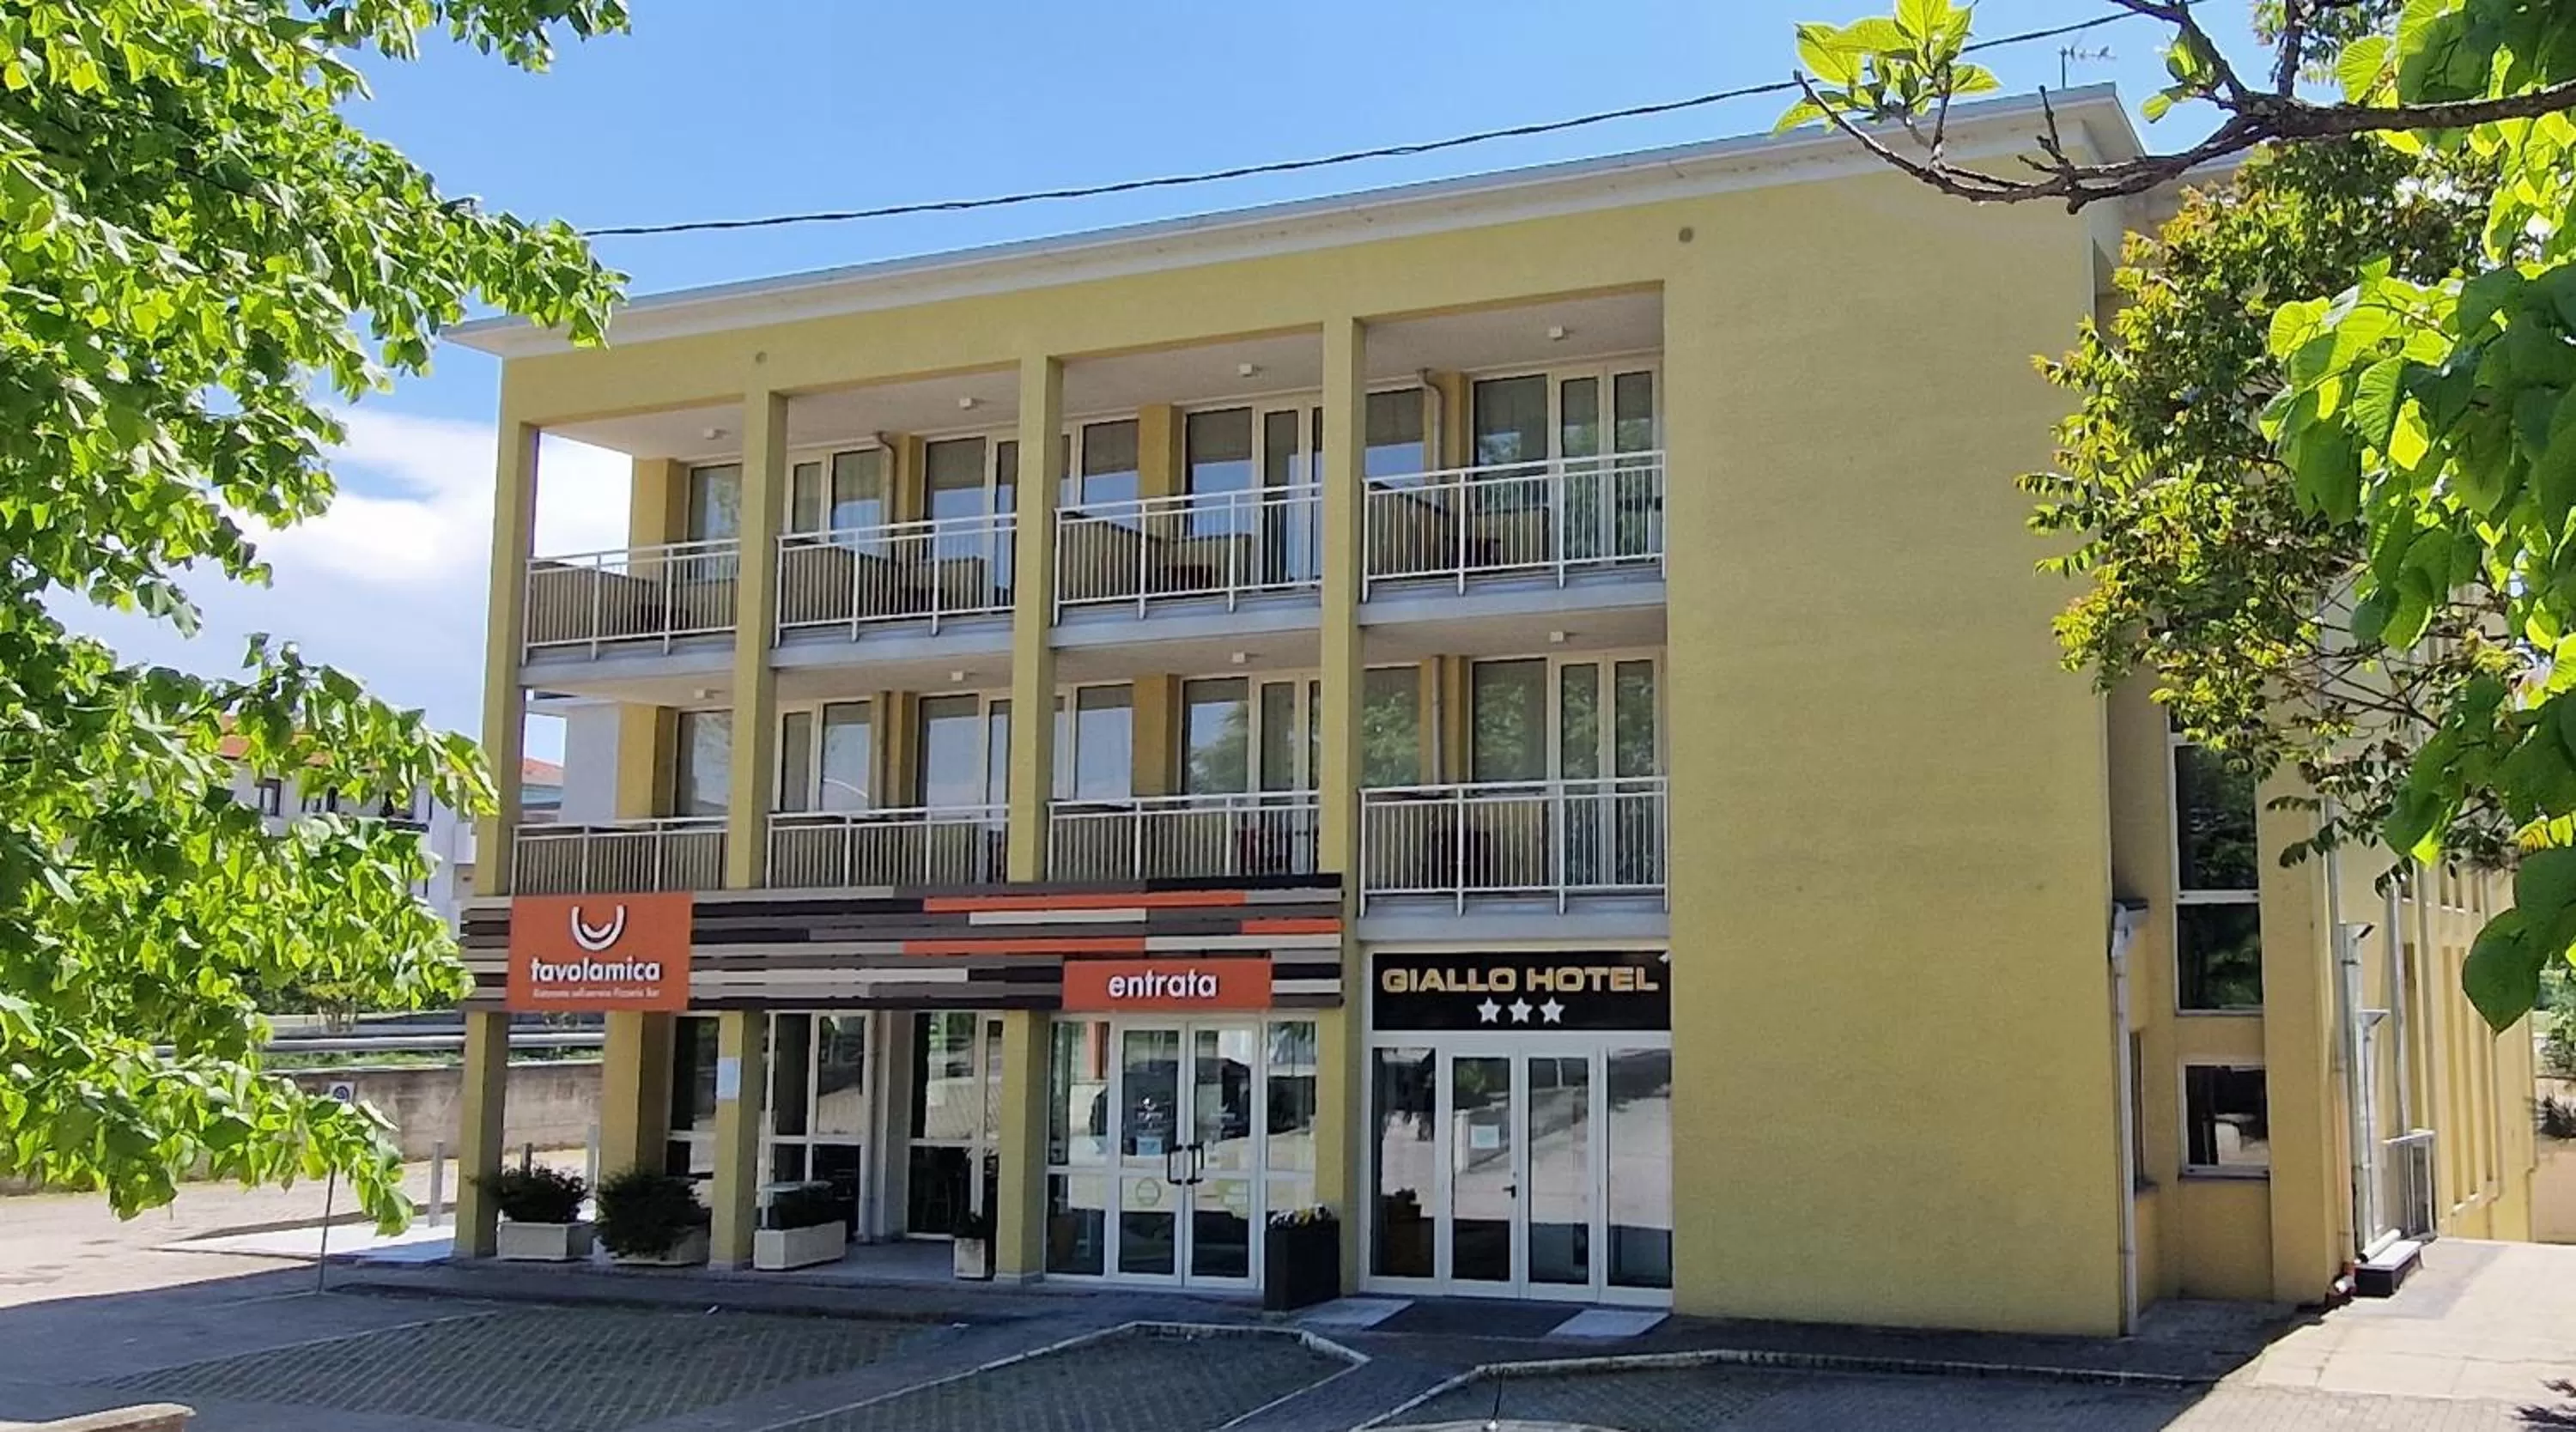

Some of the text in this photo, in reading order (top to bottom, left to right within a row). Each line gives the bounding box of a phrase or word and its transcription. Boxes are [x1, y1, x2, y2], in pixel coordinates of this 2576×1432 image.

[532, 955, 661, 982] tavolamica
[1382, 967, 1660, 993] GIALLO HOTEL
[1109, 968, 1218, 998] entrata
